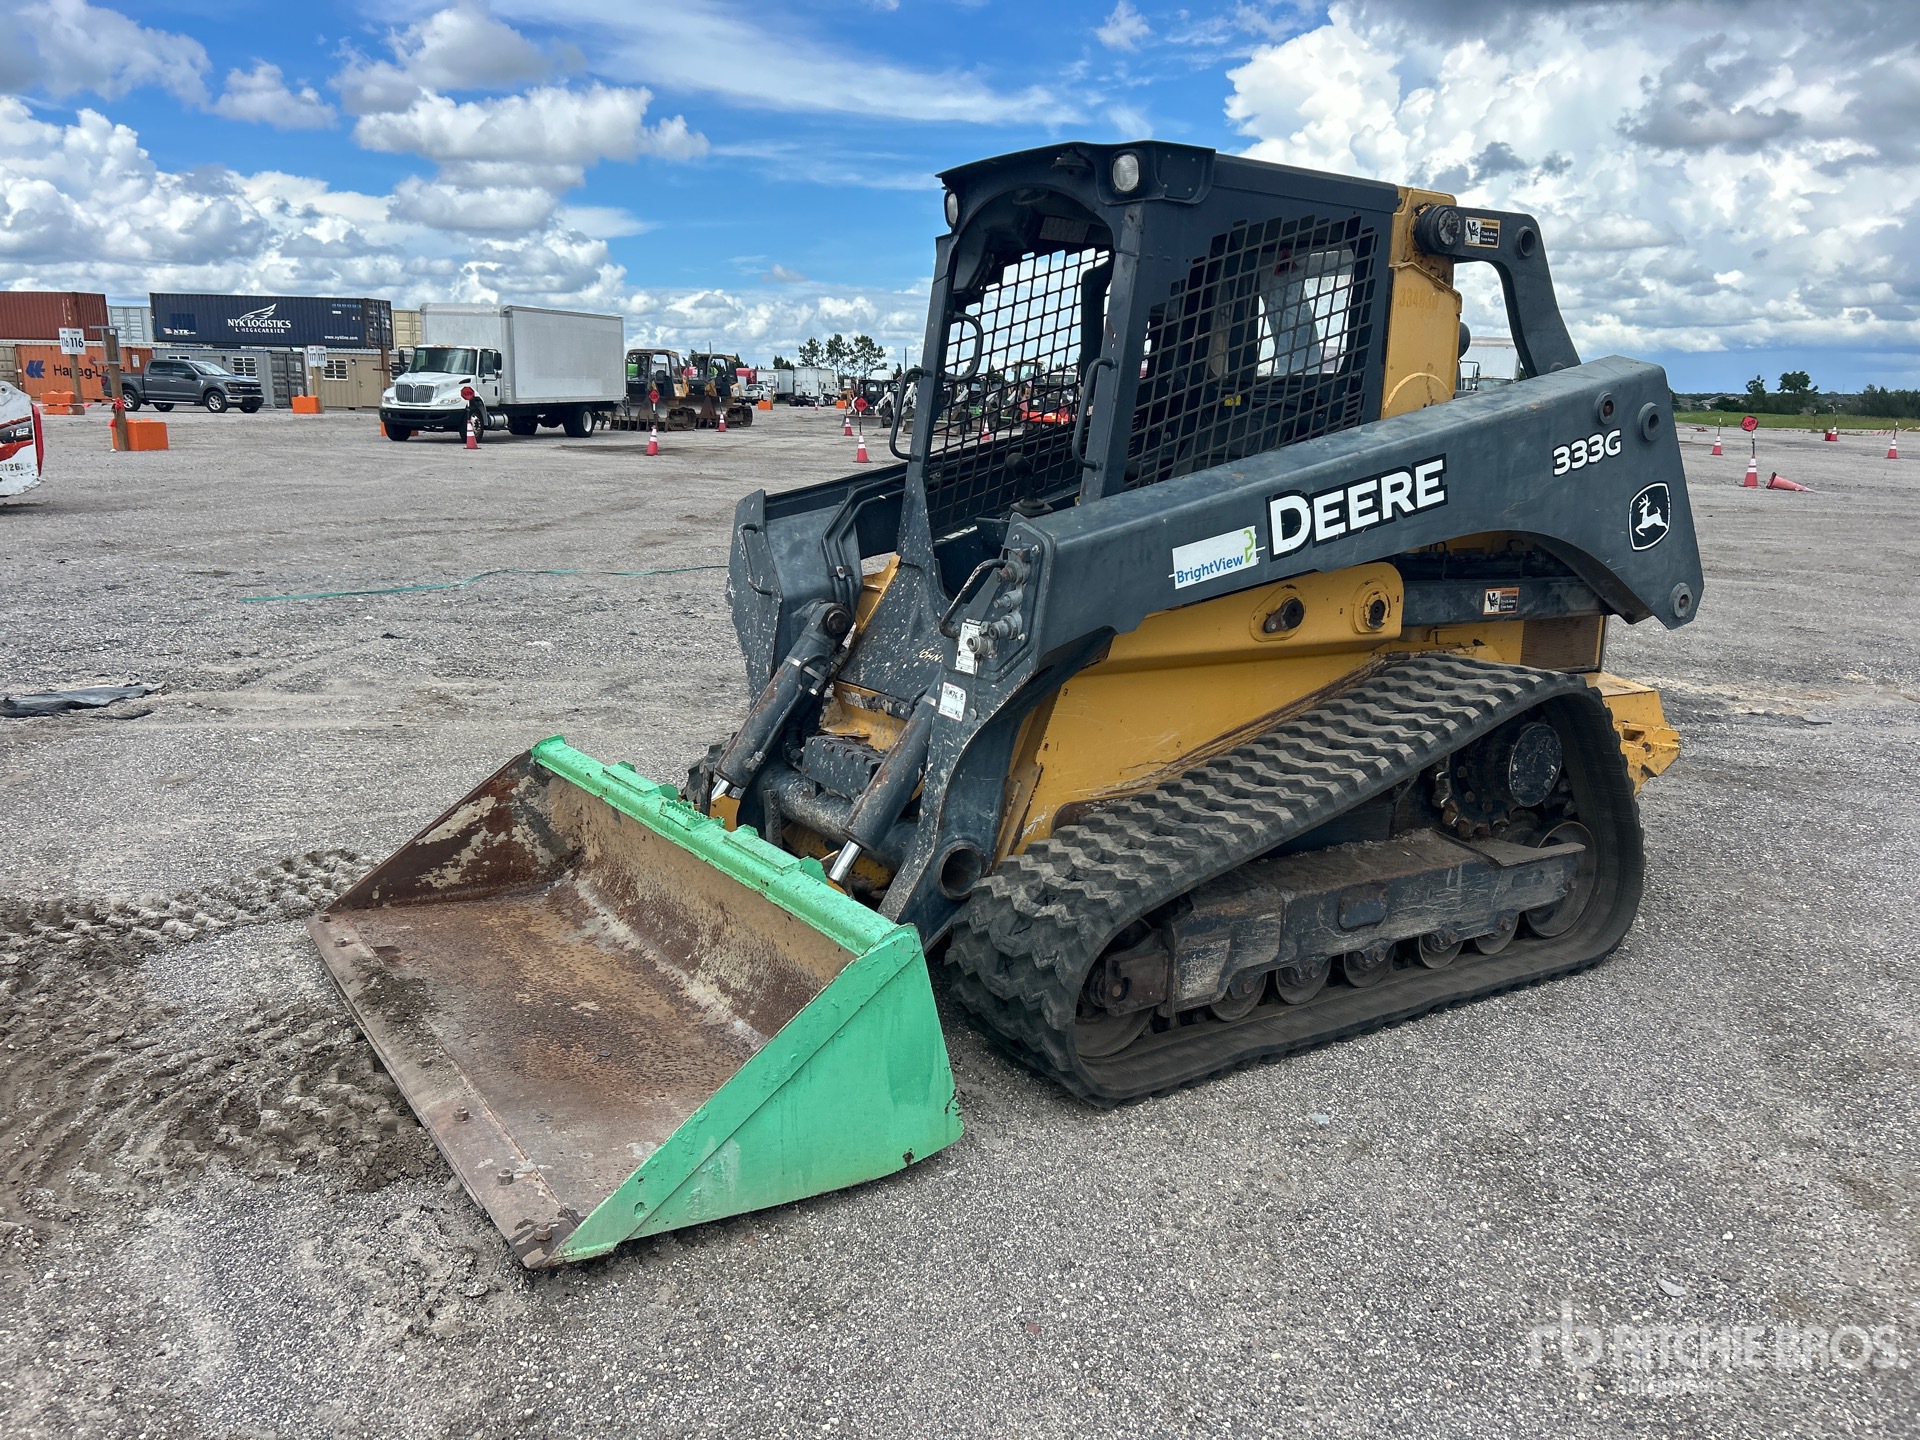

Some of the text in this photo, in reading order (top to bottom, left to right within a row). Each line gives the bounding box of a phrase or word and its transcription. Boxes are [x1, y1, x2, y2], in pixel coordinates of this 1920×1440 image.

[227, 318, 292, 328] NYK LOGISTICS
[70, 337, 84, 348] 116
[1553, 429, 1621, 475] 333G
[1269, 458, 1445, 556] DEERE
[1175, 555, 1244, 584] BrightView
